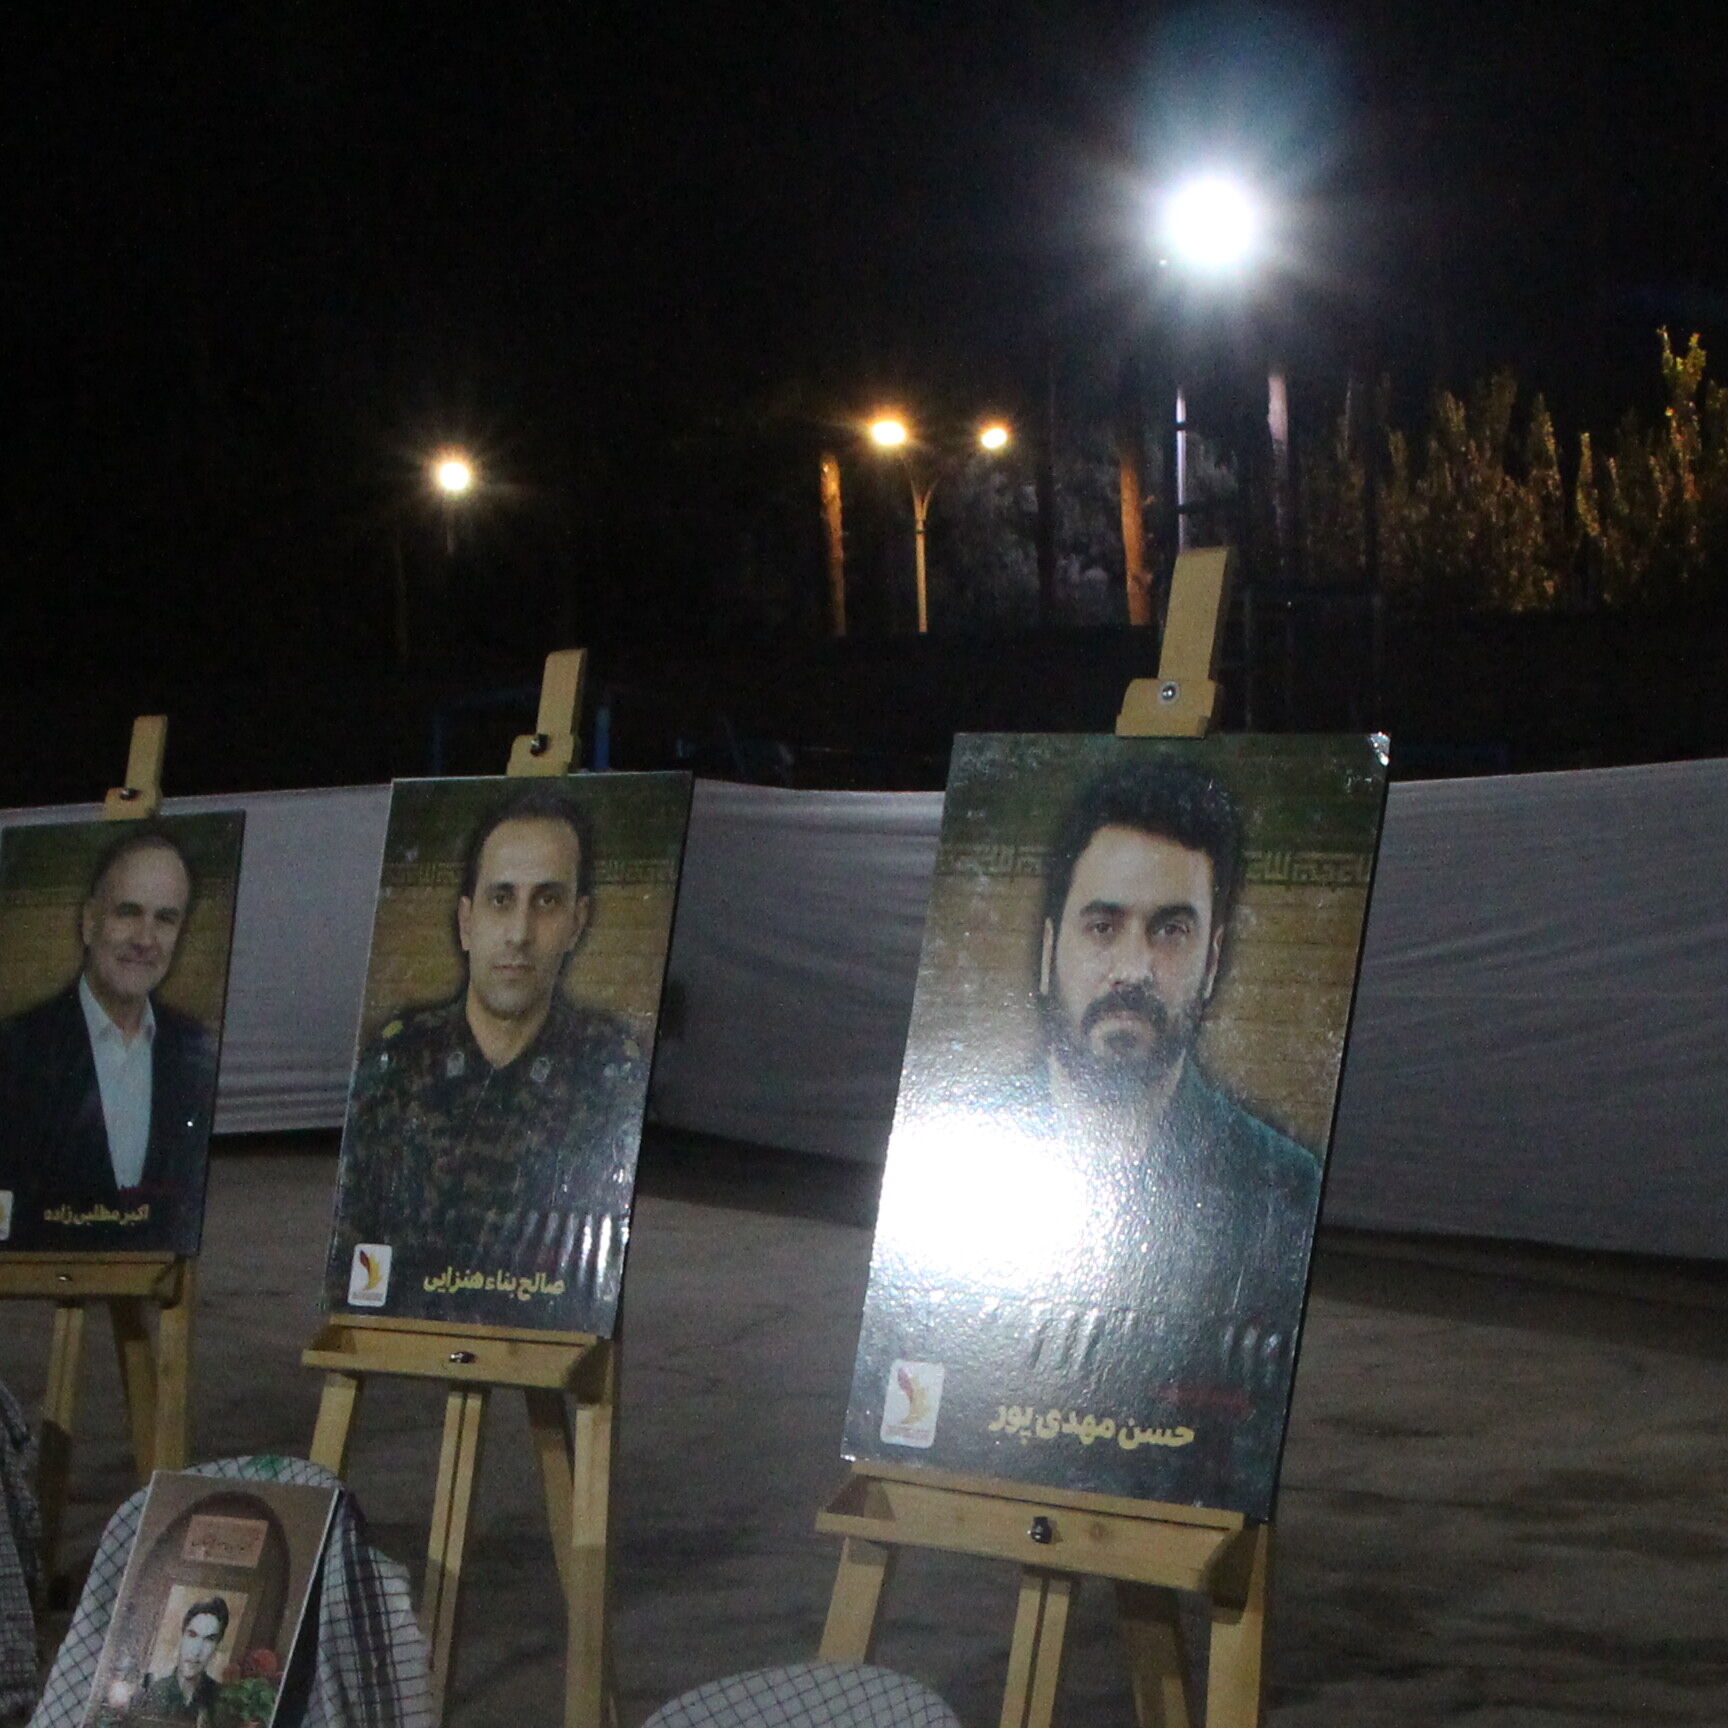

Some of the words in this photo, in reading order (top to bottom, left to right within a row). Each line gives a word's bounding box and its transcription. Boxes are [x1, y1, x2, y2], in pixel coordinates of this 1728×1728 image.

[119, 1203, 151, 1226] اکبر
[485, 1269, 516, 1298] بناء
[517, 1271, 566, 1301] صالح
[988, 1404, 1033, 1446] پور
[1035, 1408, 1116, 1445] مهدی
[1117, 1418, 1196, 1450] حسن
